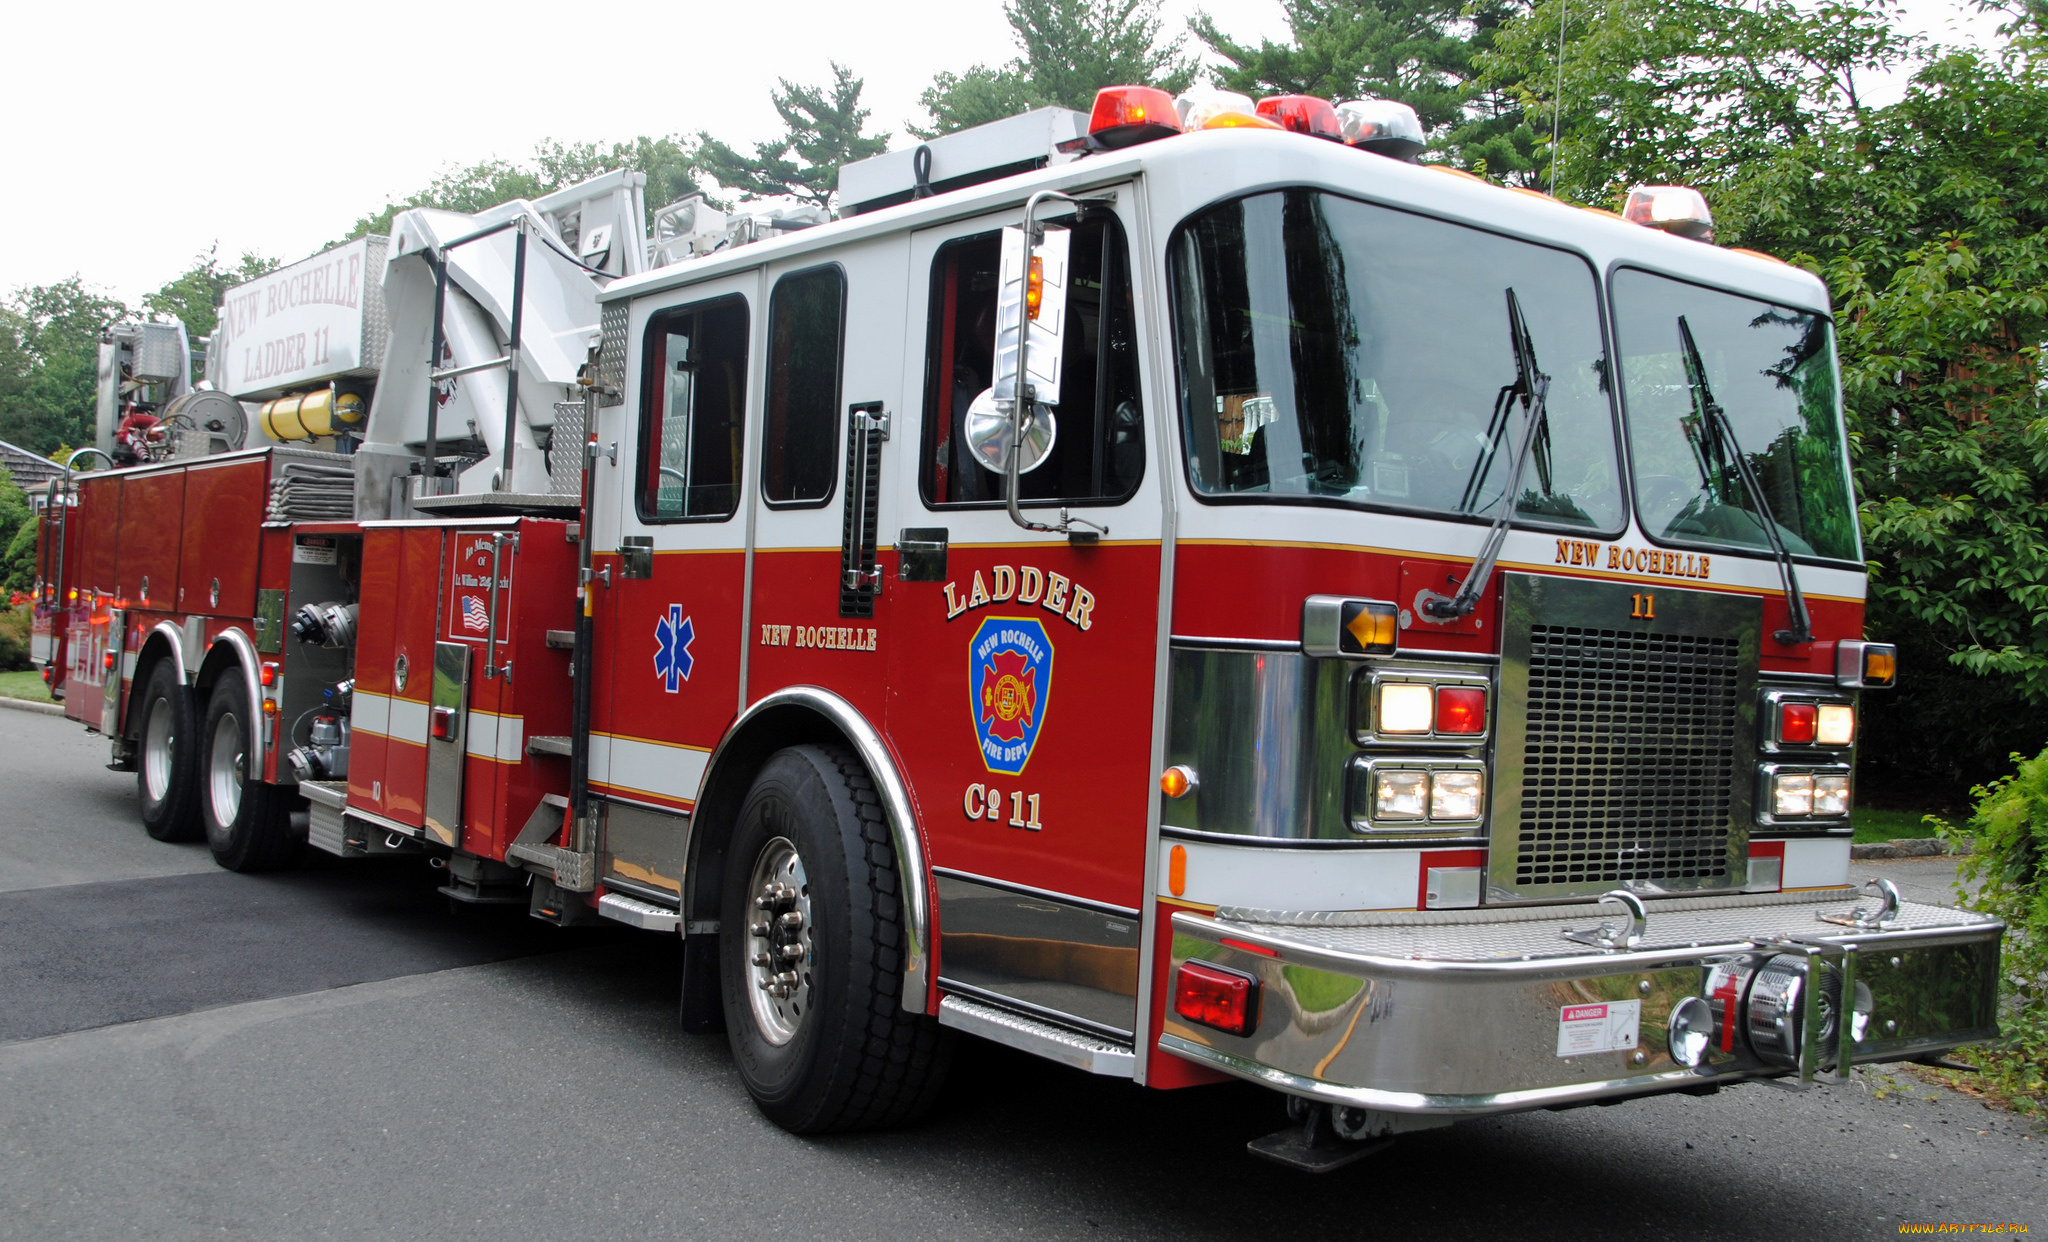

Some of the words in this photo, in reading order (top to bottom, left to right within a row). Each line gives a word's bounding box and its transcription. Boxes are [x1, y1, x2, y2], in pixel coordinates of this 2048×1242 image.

[227, 290, 261, 347] NEW
[266, 253, 360, 317] ROCHELLE
[243, 332, 306, 383] LADDER
[312, 325, 329, 366] 11
[1555, 539, 1600, 567] NEW
[1607, 545, 1710, 579] ROCHELLE
[943, 565, 1095, 631] LADDER
[1630, 593, 1656, 620] 11
[761, 624, 791, 646] NEW
[795, 626, 877, 652] ROCHELLE
[978, 632, 998, 660] NEW
[1001, 629, 1044, 664] ROCHELLE
[982, 737, 1002, 761] FIRE
[1004, 742, 1028, 762] DEPT
[1009, 791, 1042, 830] 11
[1575, 1008, 1602, 1019] DANGER
